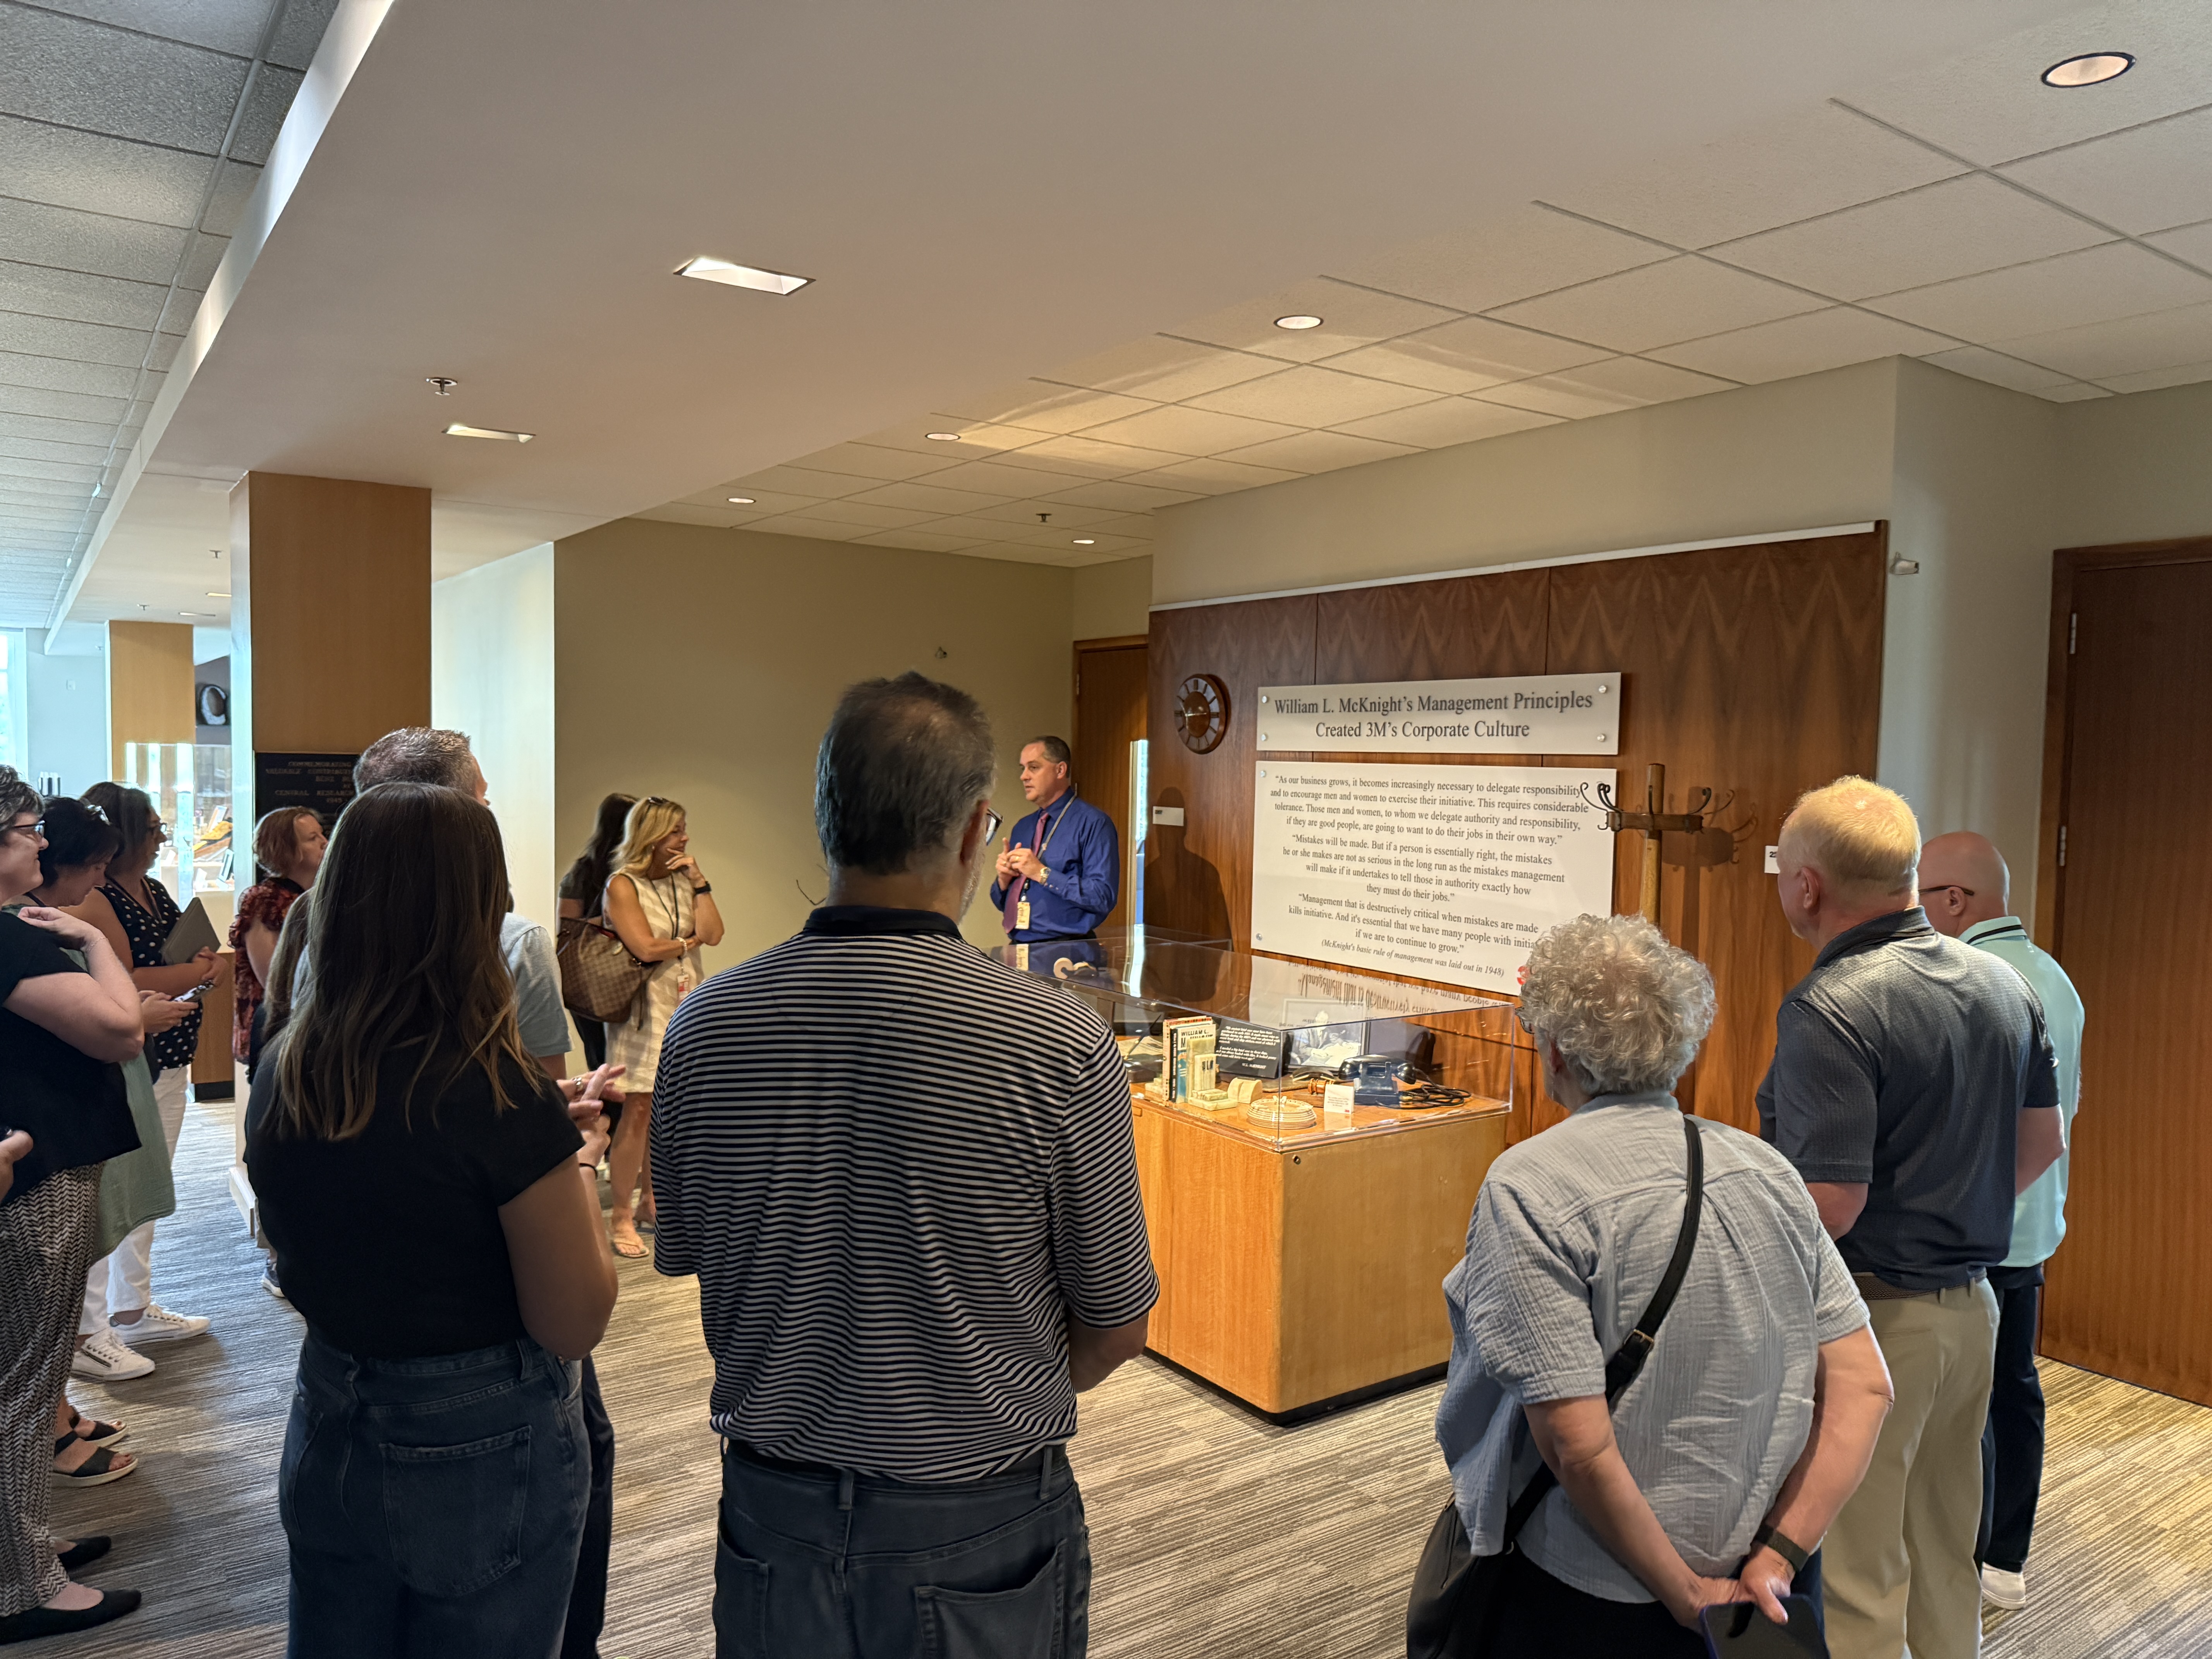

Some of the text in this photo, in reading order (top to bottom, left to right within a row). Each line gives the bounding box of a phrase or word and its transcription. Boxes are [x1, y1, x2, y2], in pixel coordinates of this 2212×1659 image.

[1275, 699, 1318, 713] William
[1323, 699, 1334, 713] L.
[1418, 696, 1508, 715] Management
[1513, 690, 1592, 713] Principles
[1316, 722, 1361, 737] Created
[1402, 721, 1469, 741] Corporate
[1474, 720, 1530, 737] Culture
[1301, 776, 1327, 785] business
[1329, 780, 1350, 788] grows,
[1353, 778, 1357, 786] it
[1359, 778, 1389, 788] becomes
[1391, 779, 1435, 792] increasingly
[1437, 783, 1474, 793] necessary
[1486, 782, 1520, 795] delegate
[1271, 788, 1281, 797] and
[1290, 792, 1322, 801] encourage
[1339, 792, 1351, 800] and
[1388, 794, 1417, 804] exercise
[1420, 795, 1437, 805] their
[1439, 796, 1475, 807] initiative.
[1478, 798, 1495, 808] This
[1498, 799, 1531, 811] requires
[1533, 802, 1589, 813] considerable
[1275, 802, 1304, 811] tolerance.
[1306, 804, 1325, 813] Those
[1342, 806, 1354, 814] and
[1356, 809, 1382, 817] women,
[1394, 809, 1415, 819] whom
[1431, 811, 1462, 823] delegate
[1464, 813, 1500, 826] authority
[1503, 816, 1517, 825] and
[1520, 818, 1580, 831] responsibility,
[1286, 816, 1292, 824] if
[1293, 817, 1306, 828] they
[1319, 819, 1335, 829] good
[1337, 821, 1360, 831] people,
[1375, 823, 1395, 834] going
[1435, 826, 1444, 836] do
[1447, 827, 1465, 837] their
[1465, 828, 1483, 840] jobs
[1486, 830, 1493, 839] in
[1496, 831, 1515, 841] their
[1326, 837, 1338, 845] will
[1340, 838, 1347, 847] be
[1350, 839, 1369, 848] made.
[1372, 840, 1384, 850] But
[1386, 842, 1392, 850] if
[1400, 845, 1423, 854] person
[1426, 845, 1432, 854] is
[1434, 847, 1474, 860] essentially
[1476, 849, 1498, 861] right,
[1501, 851, 1513, 861] the
[1515, 853, 1552, 865] mistakes
[1283, 847, 1290, 855] he
[1300, 848, 1310, 857] she
[1312, 850, 1332, 859] makes
[1367, 855, 1392, 865] serious
[1394, 857, 1400, 866] in
[1403, 858, 1414, 867] the
[1416, 859, 1432, 871] long
[1460, 863, 1471, 873] the
[1474, 865, 1508, 877] mistakes
[1511, 871, 1565, 883] management
[1306, 863, 1318, 872] will
[1320, 865, 1337, 874] make
[1339, 866, 1345, 874] if
[1346, 867, 1350, 875] it
[1353, 868, 1389, 879] undertakes
[1400, 873, 1411, 882] tell
[1414, 874, 1433, 884] those
[1436, 876, 1442, 885] in
[1445, 878, 1479, 891] authority
[1482, 883, 1511, 895] exactly
[1513, 884, 1531, 895] how
[1367, 883, 1381, 895] they
[1402, 888, 1411, 896] do
[1413, 889, 1430, 899] their
[1289, 905, 1302, 915] kills
[1304, 907, 1333, 919] initiative.
[1335, 912, 1349, 921] And
[1362, 918, 1391, 928] essential
[1394, 920, 1407, 930] that
[1422, 924, 1439, 935] have
[1442, 929, 1462, 940] many
[1465, 933, 1491, 943] people
[1493, 935, 1511, 945] with
[1514, 937, 1535, 949] initia
[1345, 899, 1357, 908] that
[1359, 900, 1365, 909] is
[1367, 902, 1412, 918] destructively
[1413, 908, 1439, 919] critical
[1442, 912, 1462, 922] when
[1464, 915, 1498, 927] mistakes
[1516, 923, 1539, 933] made
[1355, 929, 1362, 938] if
[1396, 937, 1427, 948] continue
[1357, 945, 1371, 953] basic
[1386, 950, 1393, 958] of
[1394, 952, 1433, 964] management
[1449, 960, 1462, 969] laid
[1485, 966, 1504, 977] 1948)
